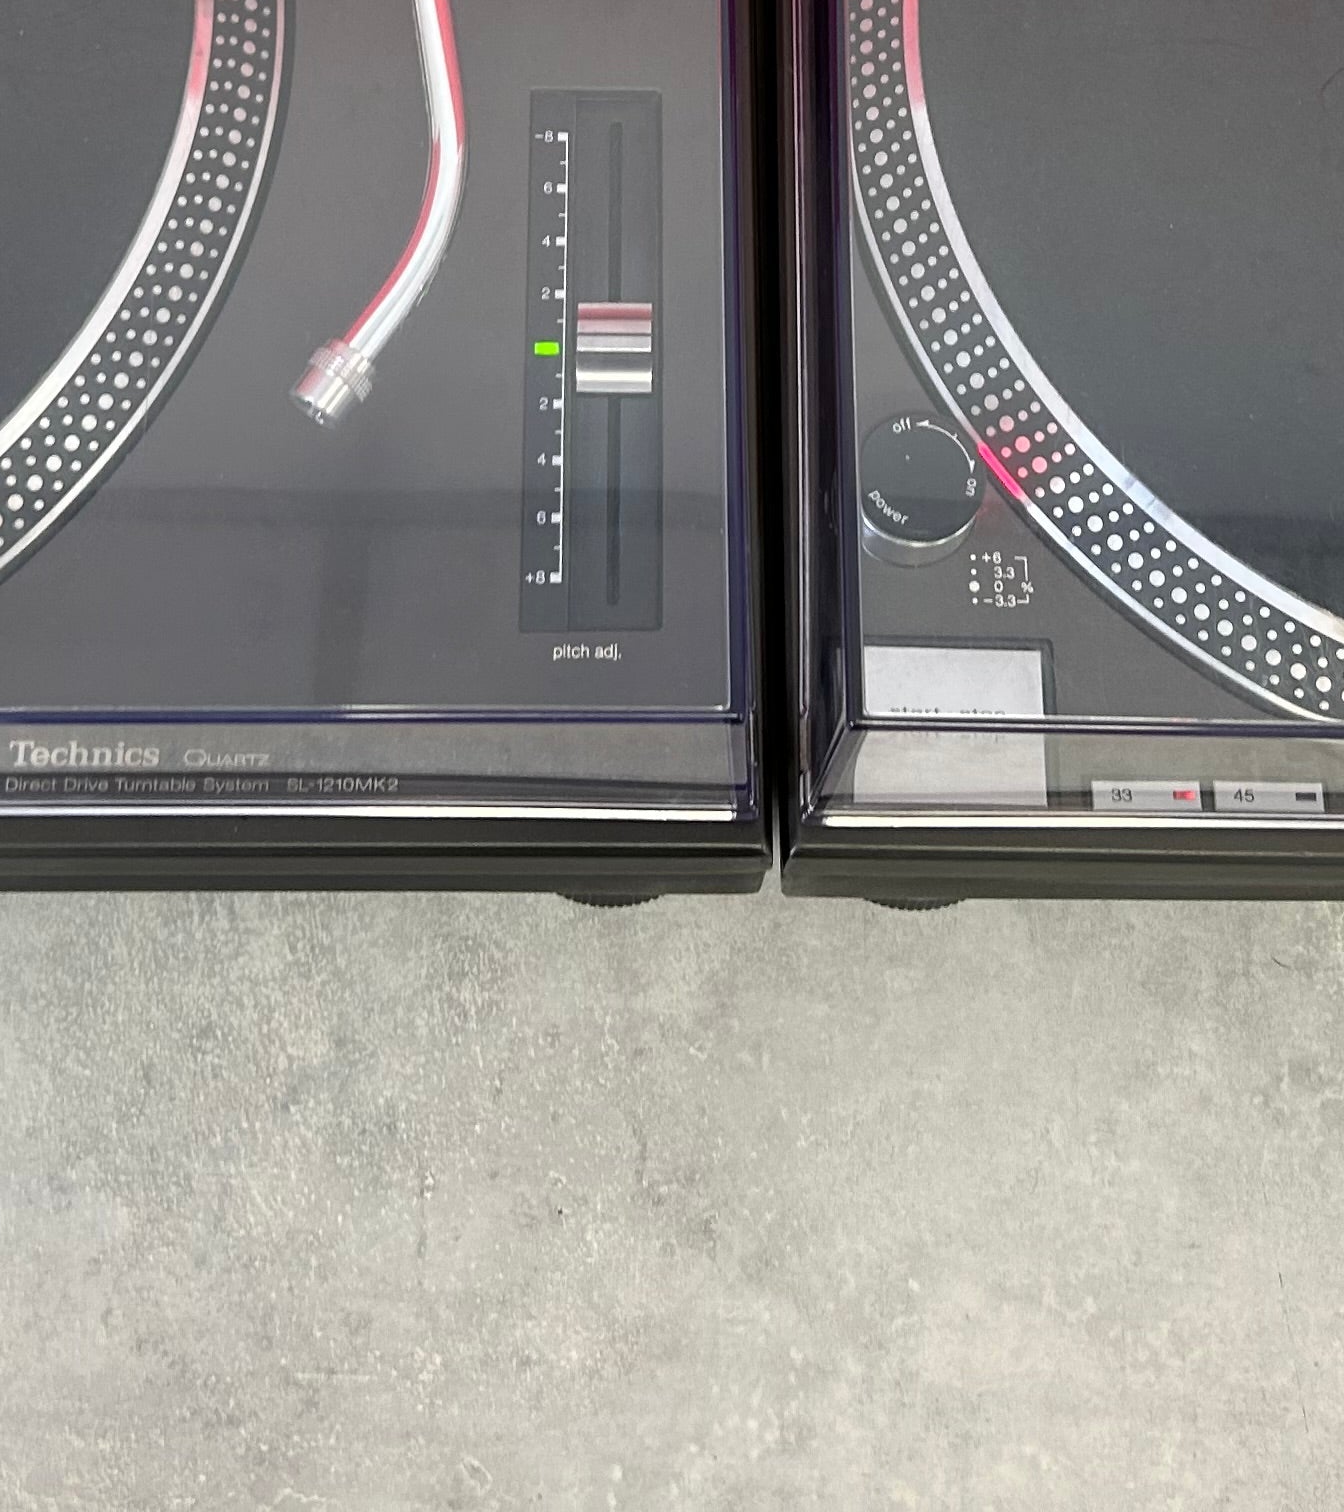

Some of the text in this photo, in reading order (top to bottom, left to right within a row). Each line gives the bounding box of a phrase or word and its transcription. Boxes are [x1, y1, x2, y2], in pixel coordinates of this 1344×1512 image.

[543, 181, 553, 195] 6
[541, 234, 551, 248] 4
[541, 286, 551, 300] 2
[539, 396, 549, 411] 2
[892, 417, 911, 434] off
[537, 452, 547, 466] 4
[868, 490, 909, 525] power
[525, 569, 545, 585] +8
[993, 566, 1015, 580] 3.3
[994, 580, 1003, 593] 0
[552, 643, 622, 662] pitch adj.
[9, 740, 270, 768] Technics QUARTZ
[5, 775, 399, 794] Direct Drive Turntable System SL-1210MK2
[1111, 787, 1134, 803] 33
[1233, 788, 1256, 803] 45
